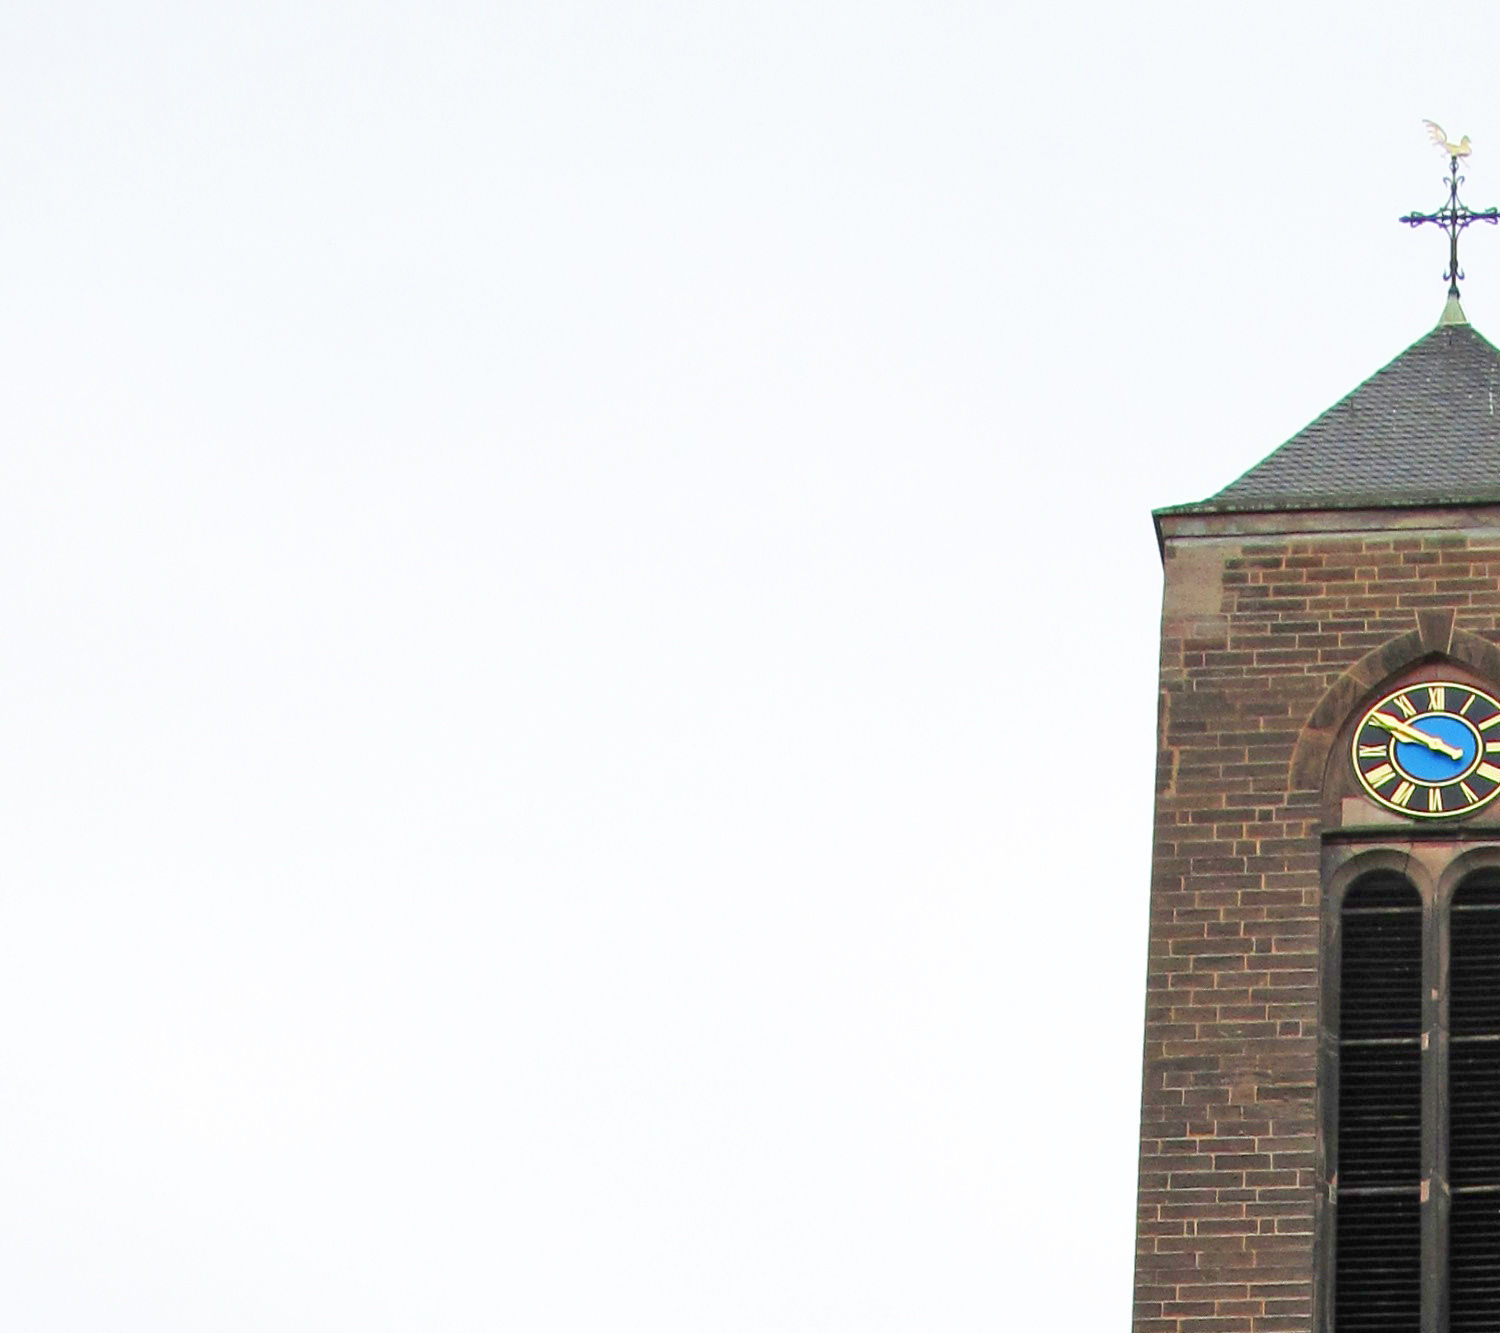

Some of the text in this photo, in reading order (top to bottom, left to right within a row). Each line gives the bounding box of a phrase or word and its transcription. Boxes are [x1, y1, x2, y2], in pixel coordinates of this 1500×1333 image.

[1393, 693, 1418, 718] XI
[1428, 686, 1445, 711] XII
[1460, 694, 1476, 715] I
[1359, 744, 1388, 757] IX
[1390, 781, 1416, 807] VII
[1428, 787, 1444, 812] VI
[1460, 781, 1479, 804] V
